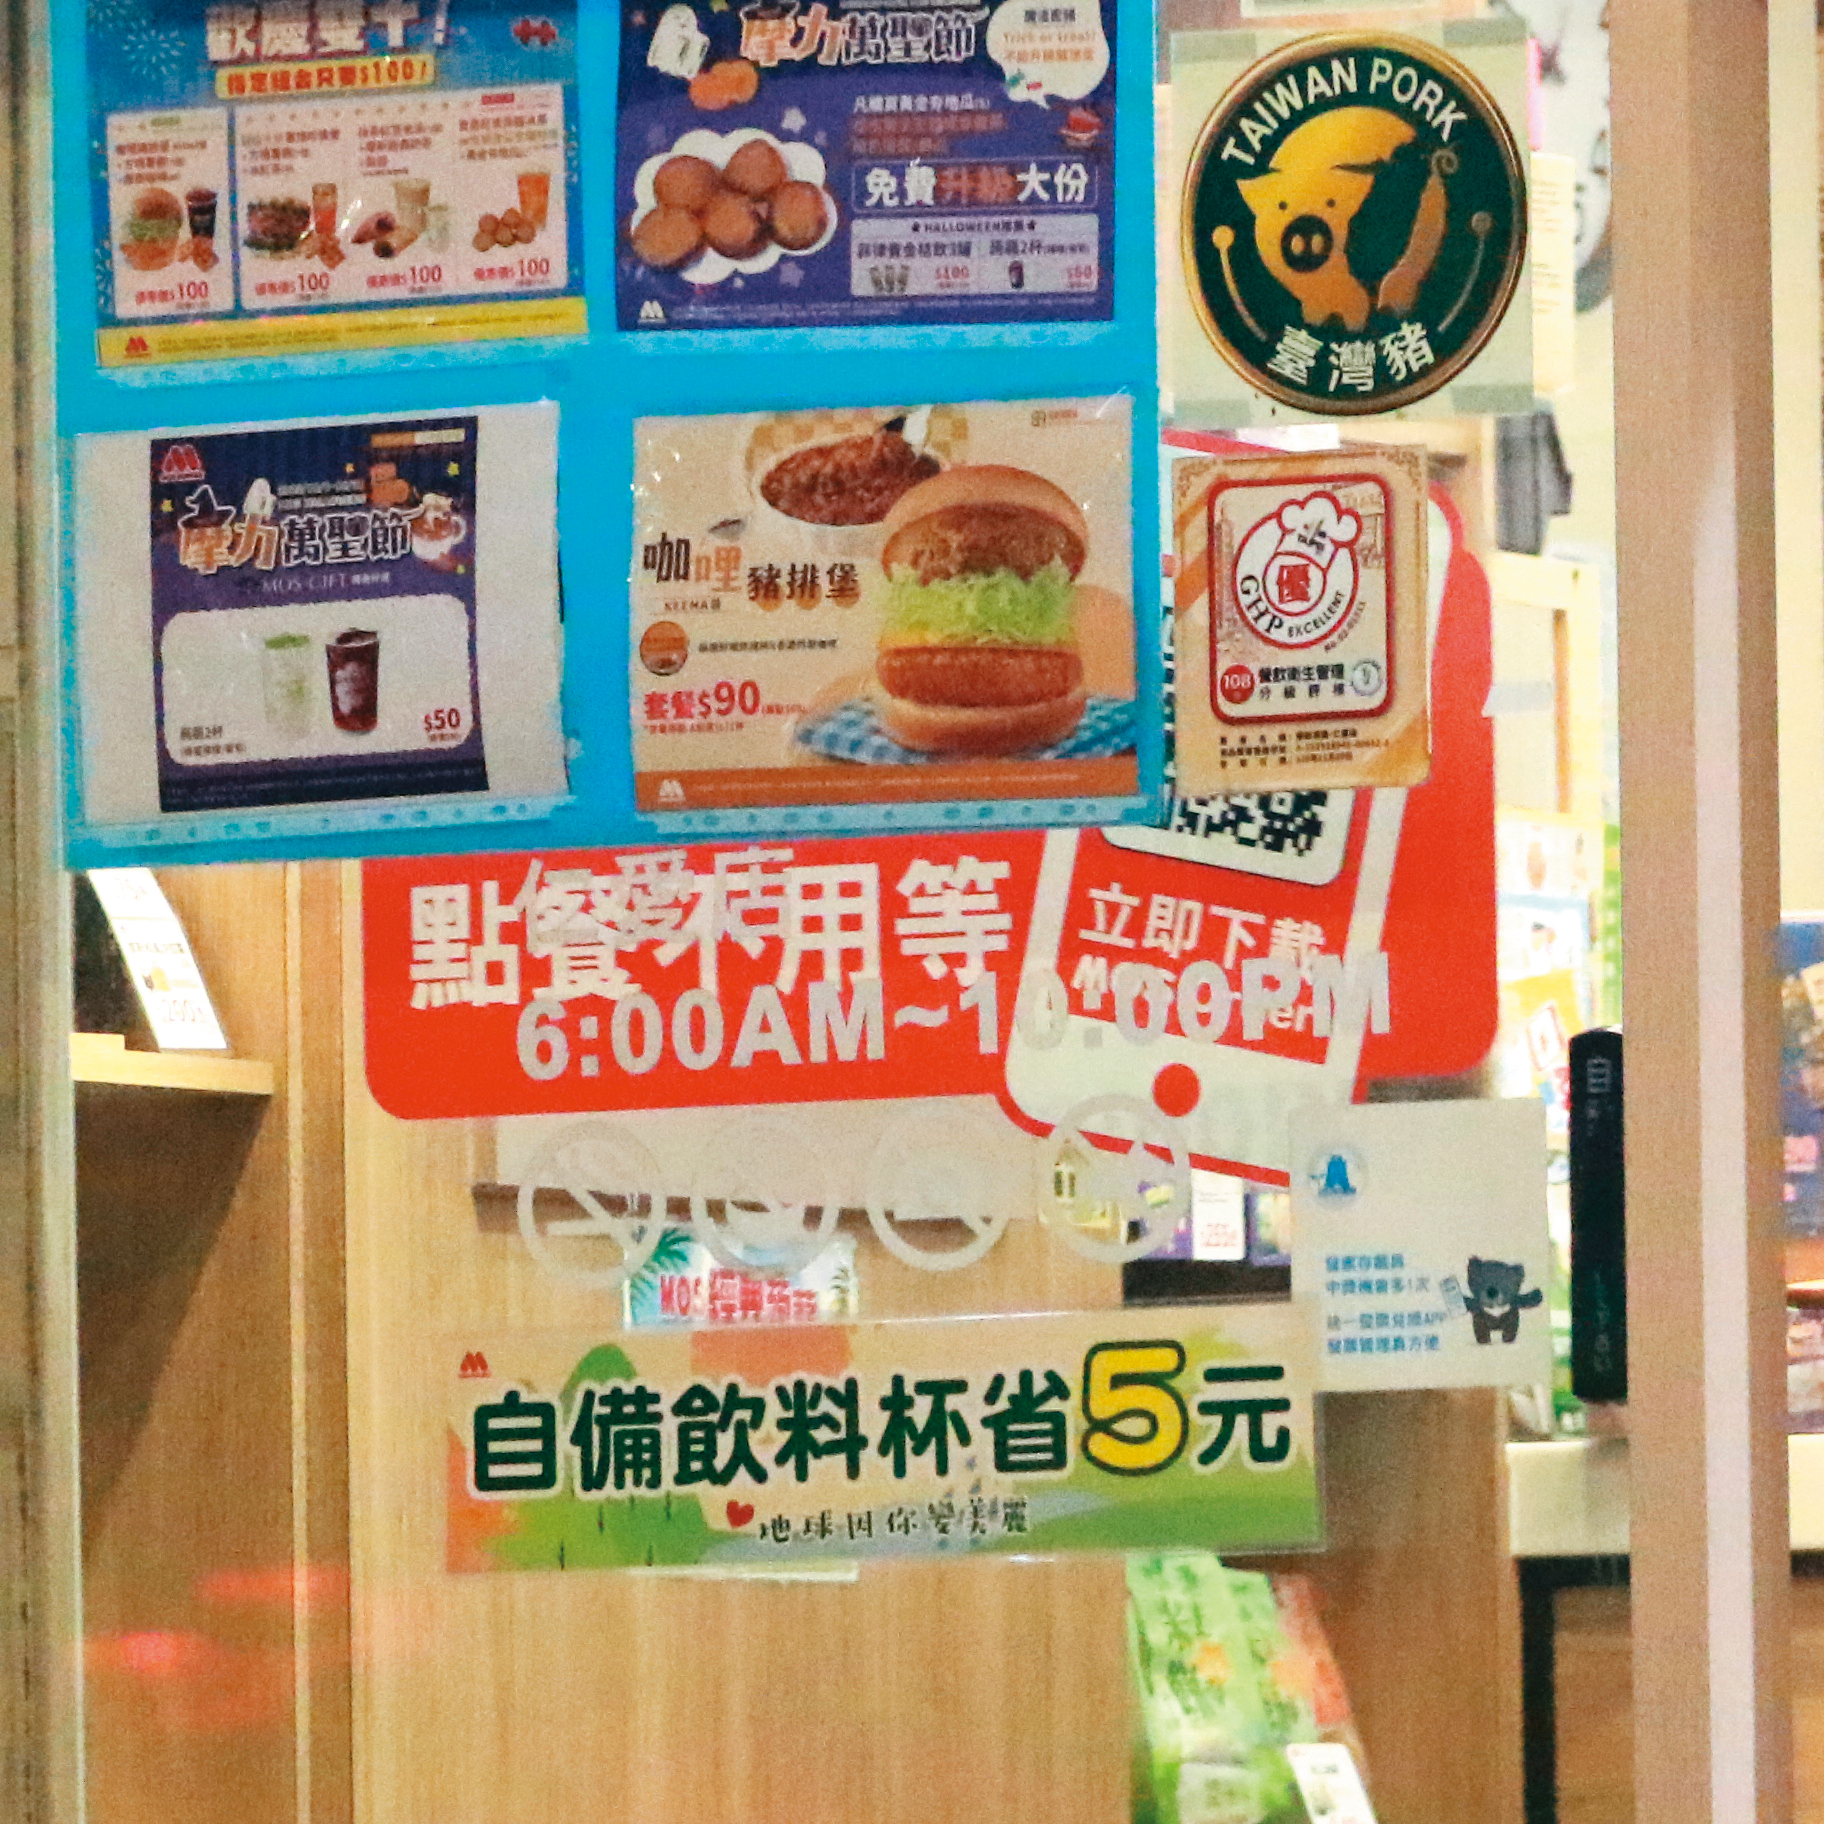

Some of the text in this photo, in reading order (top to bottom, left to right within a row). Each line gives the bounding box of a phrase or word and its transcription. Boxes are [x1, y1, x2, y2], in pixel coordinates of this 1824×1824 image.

[1220, 56, 1469, 171] TAIWAN PORK
[1265, 319, 1438, 394] 臺灣豬
[1240, 574, 1285, 634] GHP
[1287, 589, 1346, 639] EXCELLENT
[472, 1339, 1291, 1495] 自備飲料杯省5元
